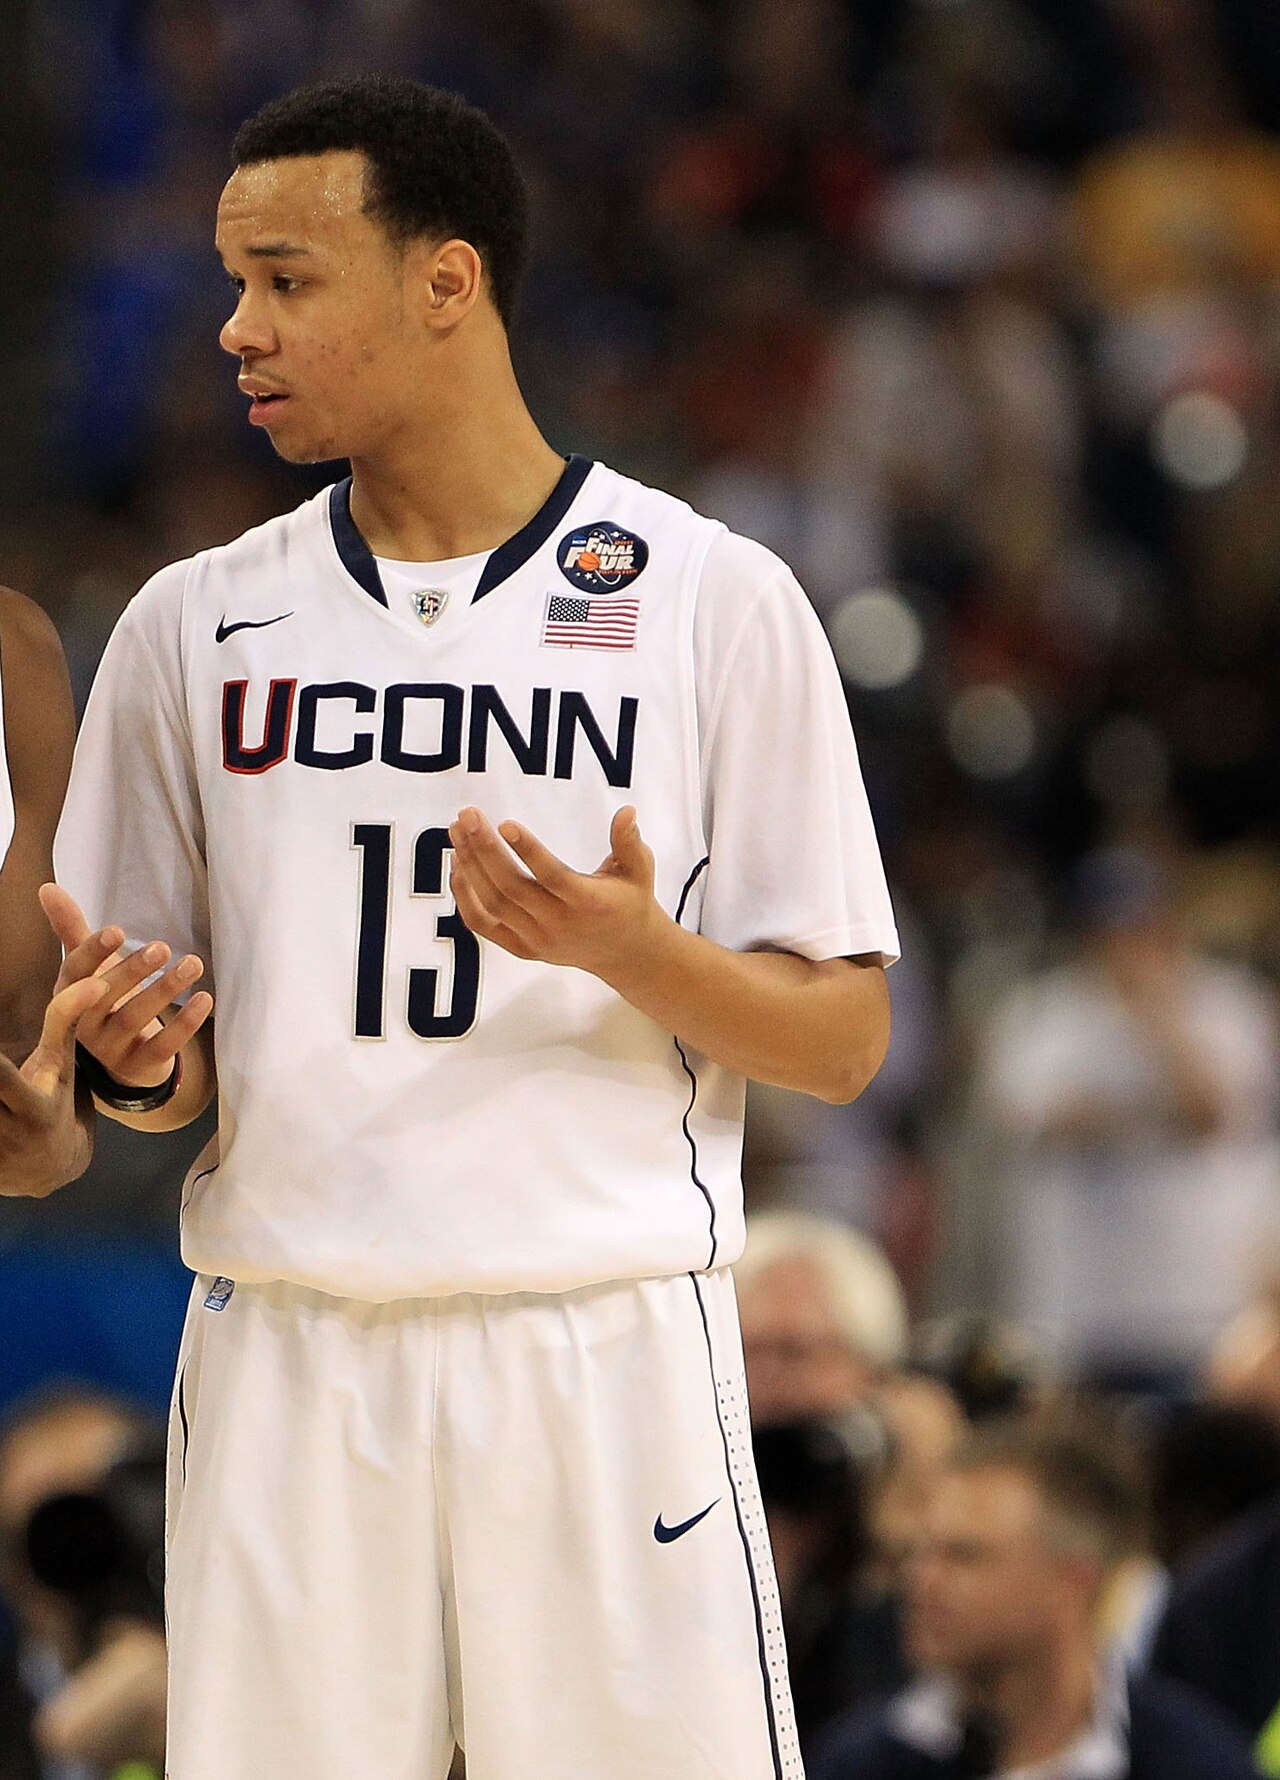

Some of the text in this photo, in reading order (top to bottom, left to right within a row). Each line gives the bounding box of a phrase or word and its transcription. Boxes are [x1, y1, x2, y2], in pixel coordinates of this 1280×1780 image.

[585, 536, 635, 556] FINAL
[222, 678, 640, 789] UCONN
[352, 822, 482, 1041] 13
